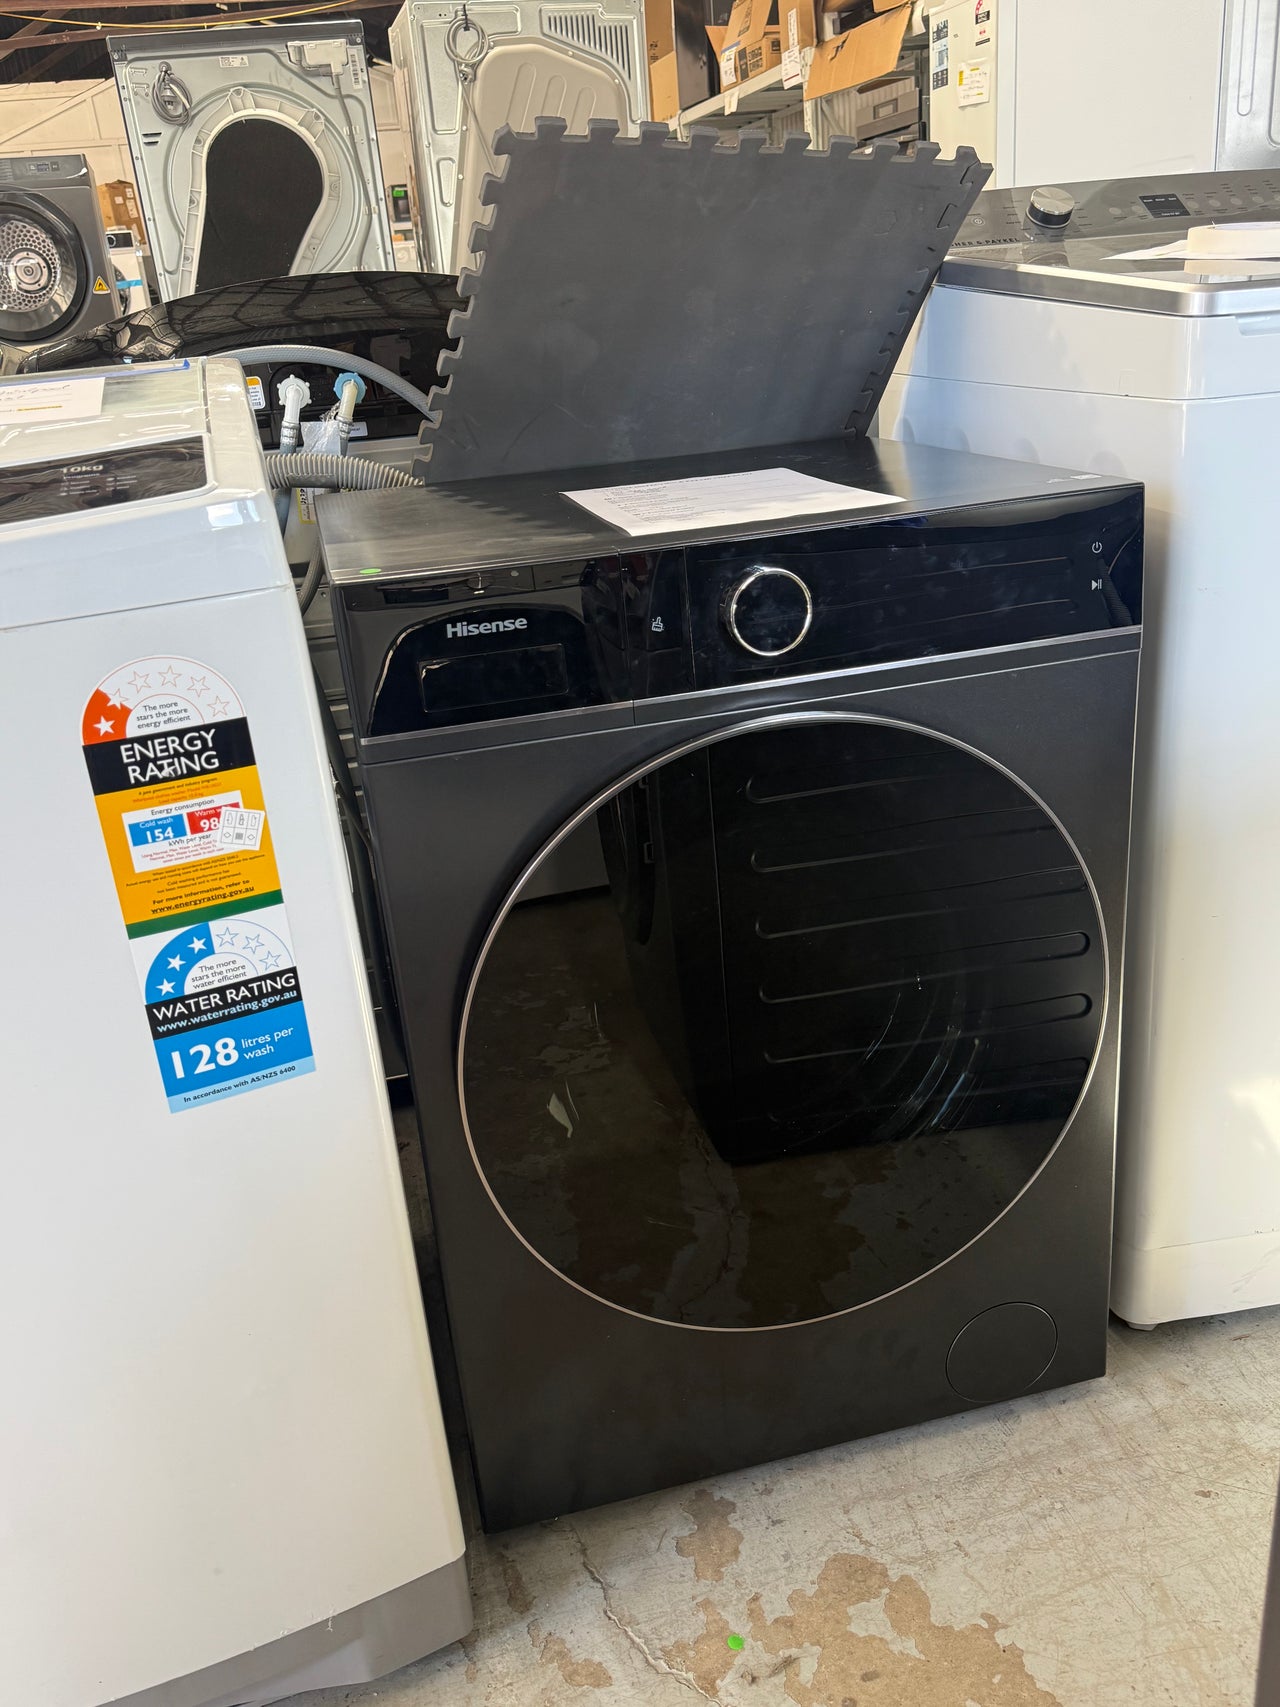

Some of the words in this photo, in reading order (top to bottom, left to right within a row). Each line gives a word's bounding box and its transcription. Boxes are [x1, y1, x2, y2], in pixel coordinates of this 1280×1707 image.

[62, 465, 103, 473] 10kg
[446, 618, 528, 638] Hisense
[137, 720, 161, 729] energy
[163, 715, 191, 724] efficient
[120, 729, 216, 763] ENERGY
[128, 751, 220, 784] RATING
[151, 807, 173, 816] Energy
[174, 799, 215, 812] consumption
[146, 827, 174, 843] 154
[168, 838, 185, 847] kWh
[186, 836, 198, 845] per
[199, 834, 212, 842] year
[151, 886, 255, 914] www.energyrating.gov.au
[166, 894, 183, 902] more
[184, 886, 224, 898] information,
[192, 972, 210, 982] stars
[211, 969, 224, 978] the
[225, 964, 246, 974] more
[198, 965, 214, 973] The
[216, 959, 237, 969] more
[193, 980, 216, 990] water
[217, 972, 247, 984] efficient
[153, 993, 223, 1021] WATER
[226, 973, 296, 1003] RATING
[157, 990, 298, 1033] www.waterrating.gov.au
[242, 1033, 271, 1049] litres
[274, 1026, 294, 1042] per
[171, 1037, 239, 1079] 128
[243, 1044, 274, 1060] wash
[193, 1085, 232, 1101] accordance
[233, 1080, 249, 1089] with
[250, 1071, 278, 1084] AS/NZS
[279, 1066, 296, 1075] 6400
